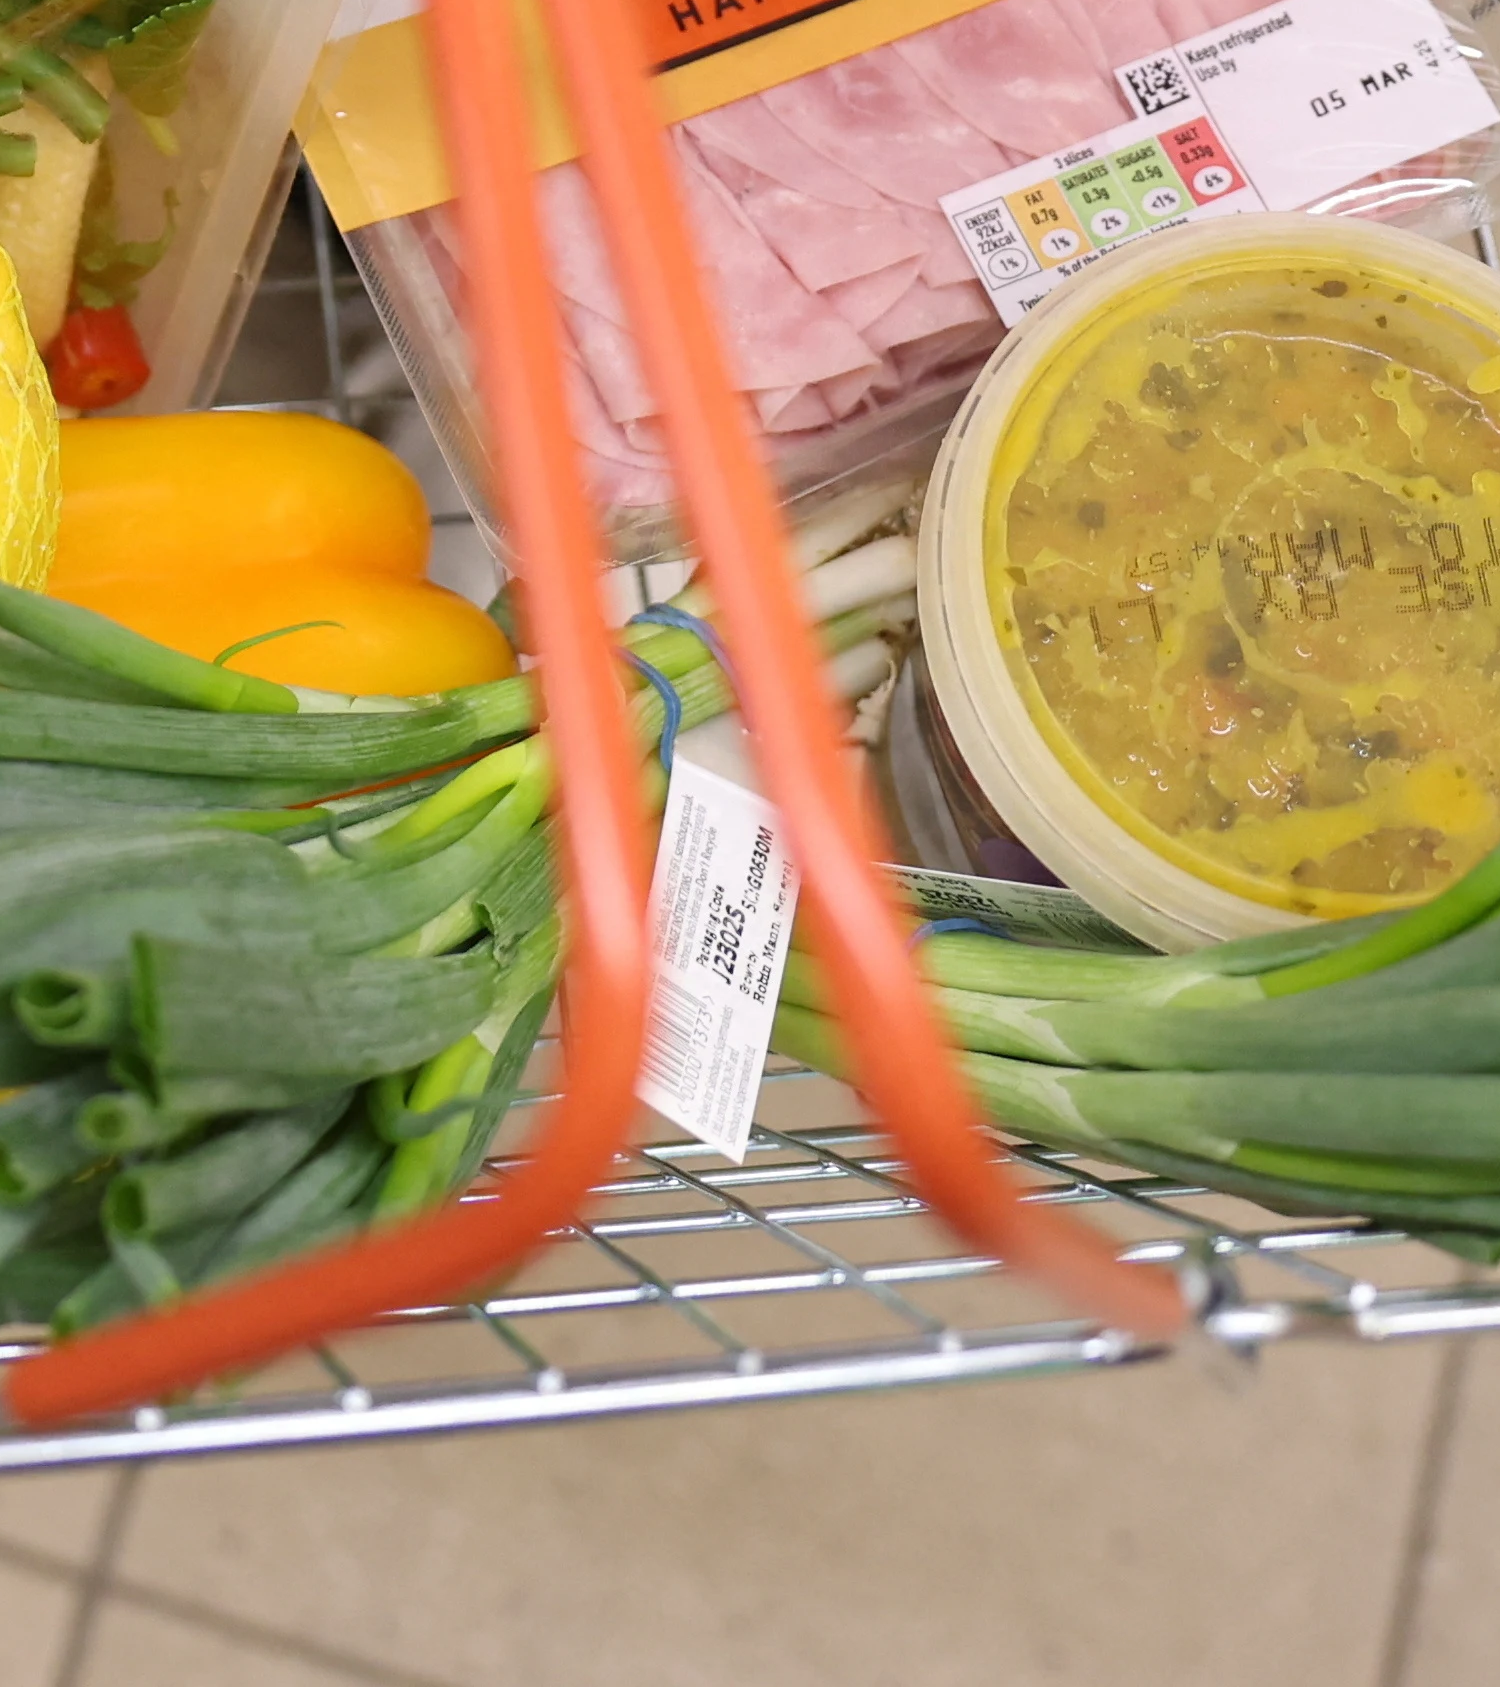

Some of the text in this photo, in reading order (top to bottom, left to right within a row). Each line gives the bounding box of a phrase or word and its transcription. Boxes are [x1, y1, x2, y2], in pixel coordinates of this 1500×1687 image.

[1184, 11, 1293, 65] Keep refrigerated
[1195, 56, 1237, 83] Use by
[1309, 61, 1413, 118] 05 MAR
[1174, 127, 1200, 145] SALT
[1063, 146, 1095, 166] slices
[1116, 146, 1156, 169] SUGARS
[1062, 164, 1109, 190] SATURATES
[1131, 166, 1165, 184] <0.5g
[1204, 173, 1224, 188] 6%
[1025, 190, 1044, 206] FAT
[1082, 187, 1111, 204] 0.3g
[1151, 193, 1176, 209] <1%
[964, 208, 1002, 230] ENERGY
[1030, 209, 1059, 226] 0.7g
[1101, 216, 1121, 231] 2%
[975, 220, 1004, 239] 92kJ
[977, 232, 1017, 255] 22kcal
[1051, 236, 1071, 251] 1%
[999, 257, 1019, 270] 1%
[1057, 265, 1071, 277] %
[1072, 260, 1082, 272] of
[702, 825, 718, 860] Recycle
[695, 859, 711, 889] Don't
[696, 884, 725, 967] Packaging Code
[712, 904, 746, 985] J2302S
[753, 962, 772, 1004] Robin
[680, 1007, 714, 1101] 0000 1373
